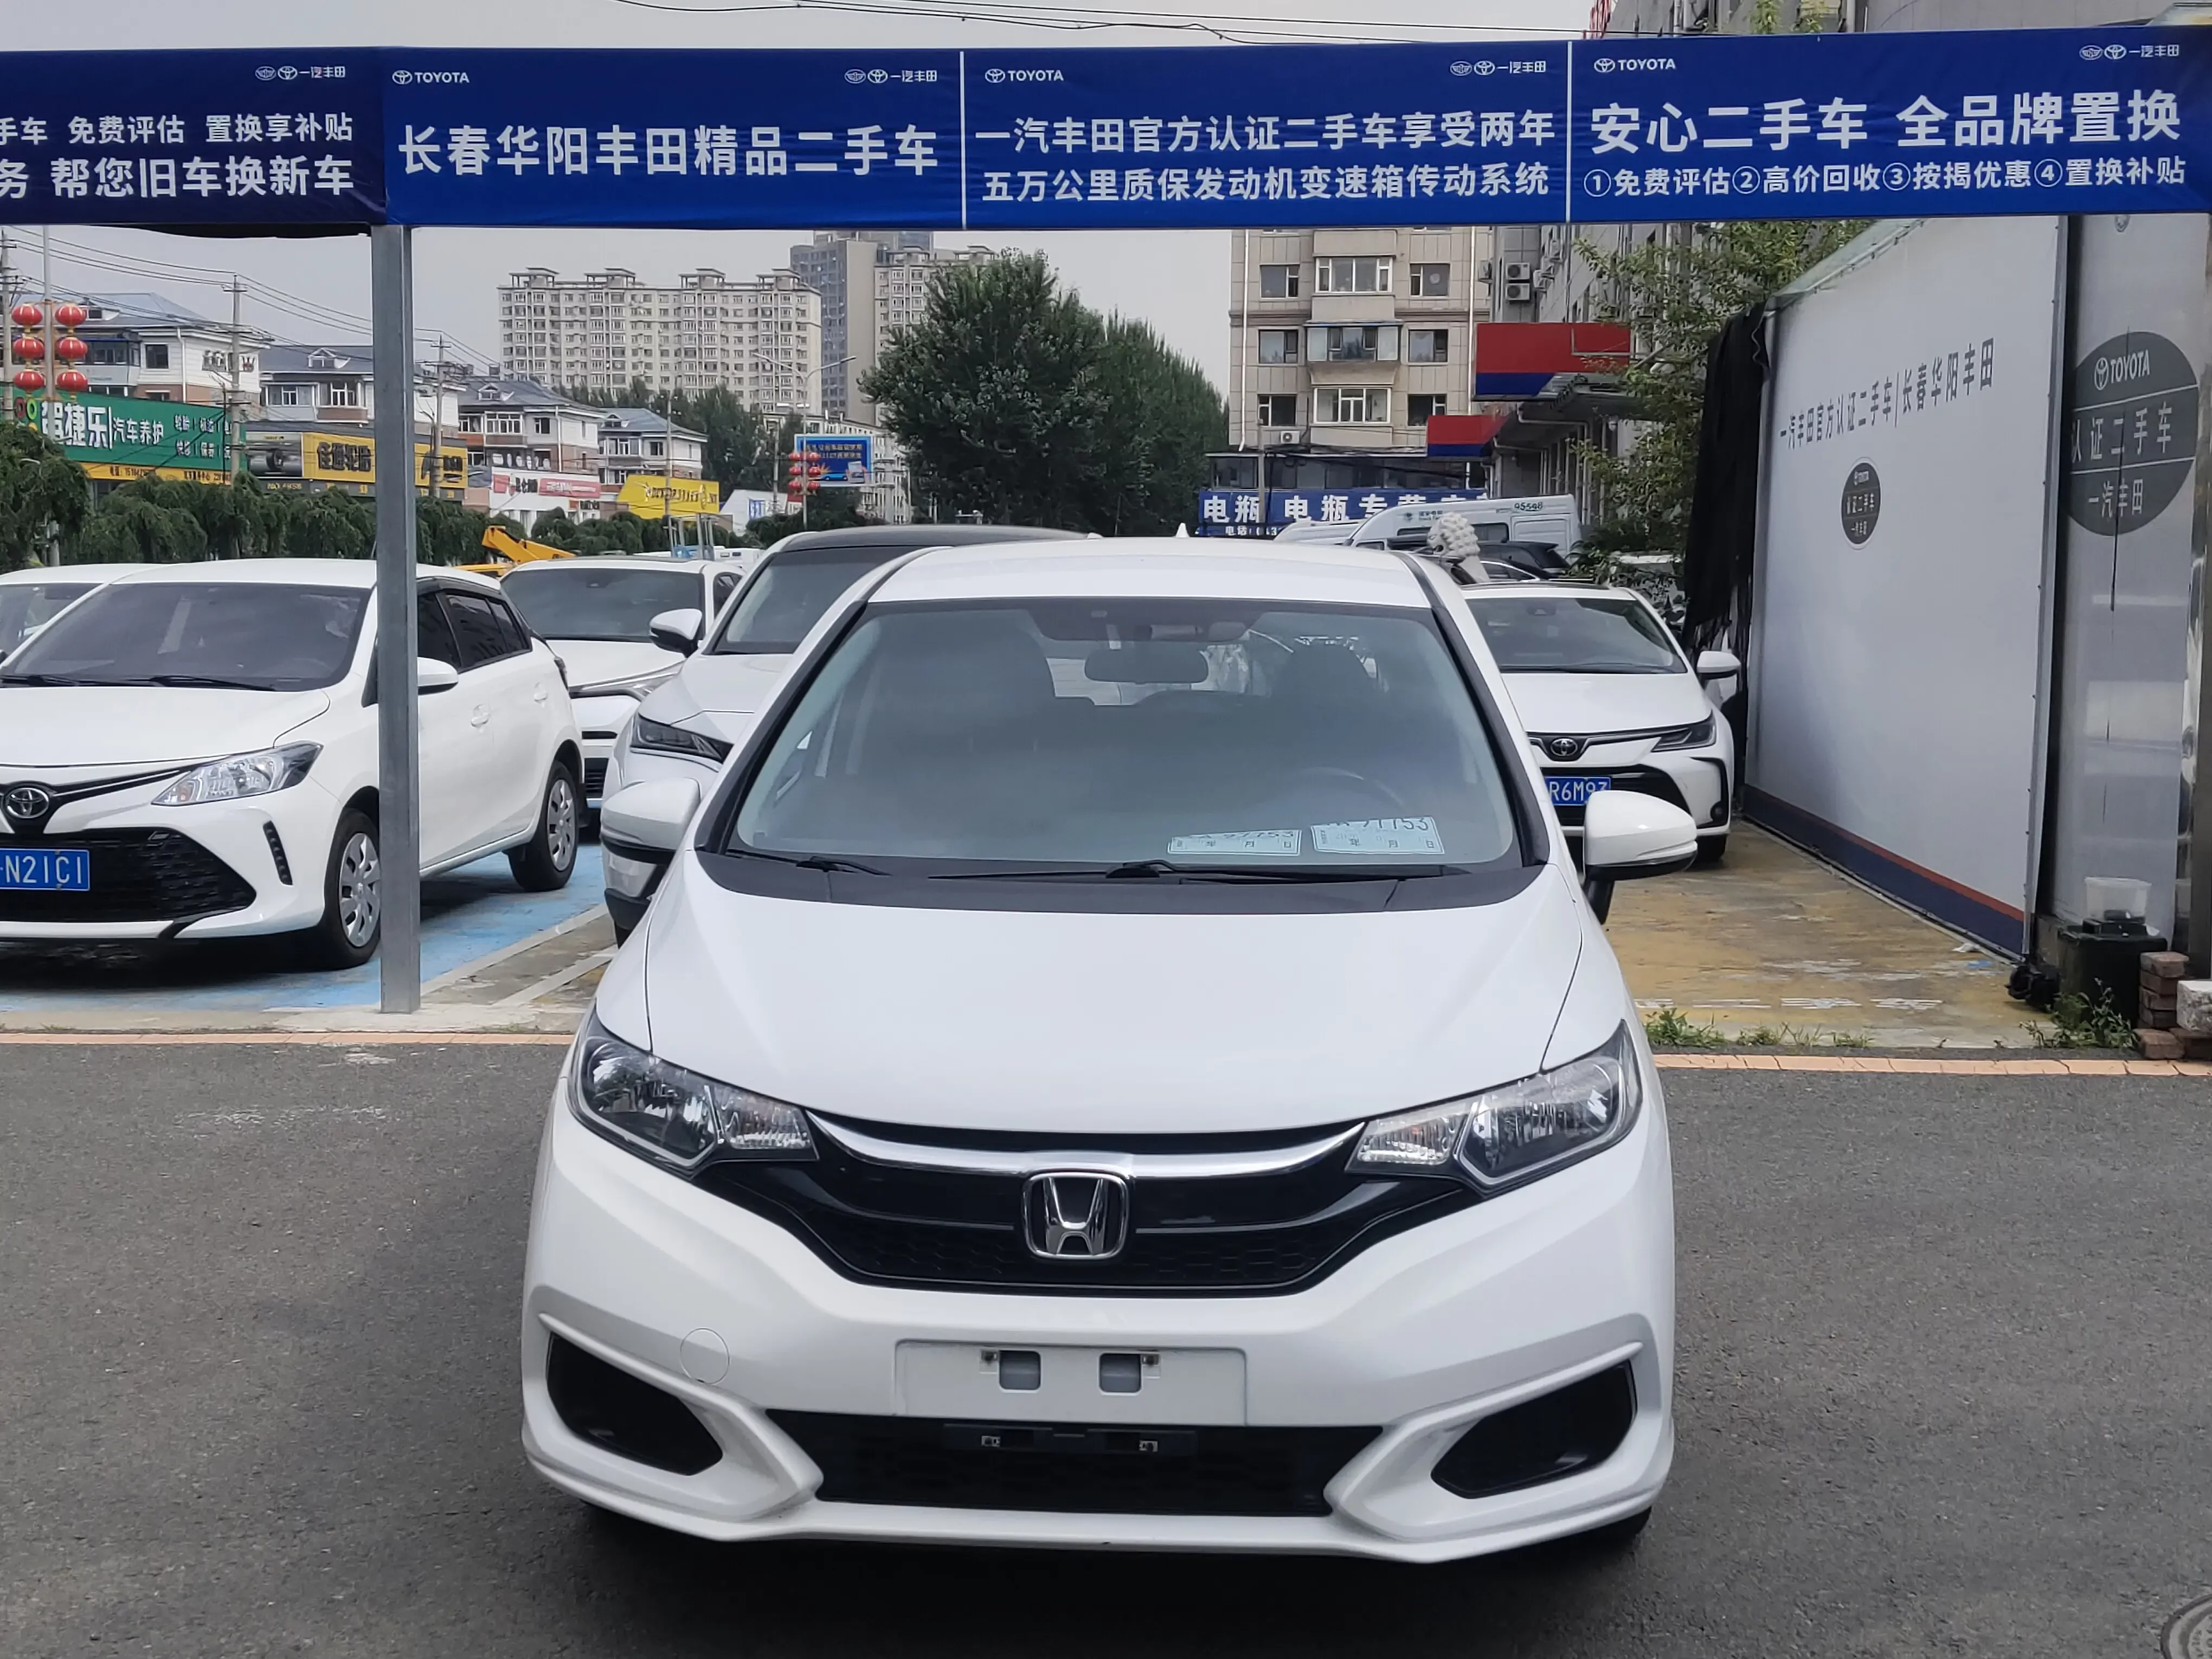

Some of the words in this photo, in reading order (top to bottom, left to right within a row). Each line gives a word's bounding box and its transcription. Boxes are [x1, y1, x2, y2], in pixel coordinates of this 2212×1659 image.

[1618, 59, 1676, 71] TOYOTA
[2129, 44, 2179, 57] 一汽丰田
[299, 66, 345, 79] 一汽丰田
[414, 72, 470, 83] TOYOTA
[891, 70, 938, 82] 一汽丰田
[1008, 70, 1064, 82] TOYOTA
[1497, 61, 1546, 74] 一汽丰田
[68, 114, 185, 144] 免费评估
[206, 112, 353, 143] 置换享补贴
[975, 108, 1555, 153] 一汽丰田官方认证二手车享受两年
[1591, 97, 1868, 154] 安心二手车
[1896, 89, 2181, 146] 全品牌置换
[398, 124, 938, 175] 长春华阳丰田精品二手车
[51, 154, 354, 198] 帮您旧车换新车
[982, 161, 1549, 202] 五万公里质保发动机变速箱传动系统
[2110, 349, 2150, 384] TOYOTA
[112, 416, 164, 445] 汽车养护
[2071, 401, 2172, 464] 认证二手车
[1203, 494, 1261, 523] 电瓶
[2088, 479, 2144, 519] 一汽丰田
